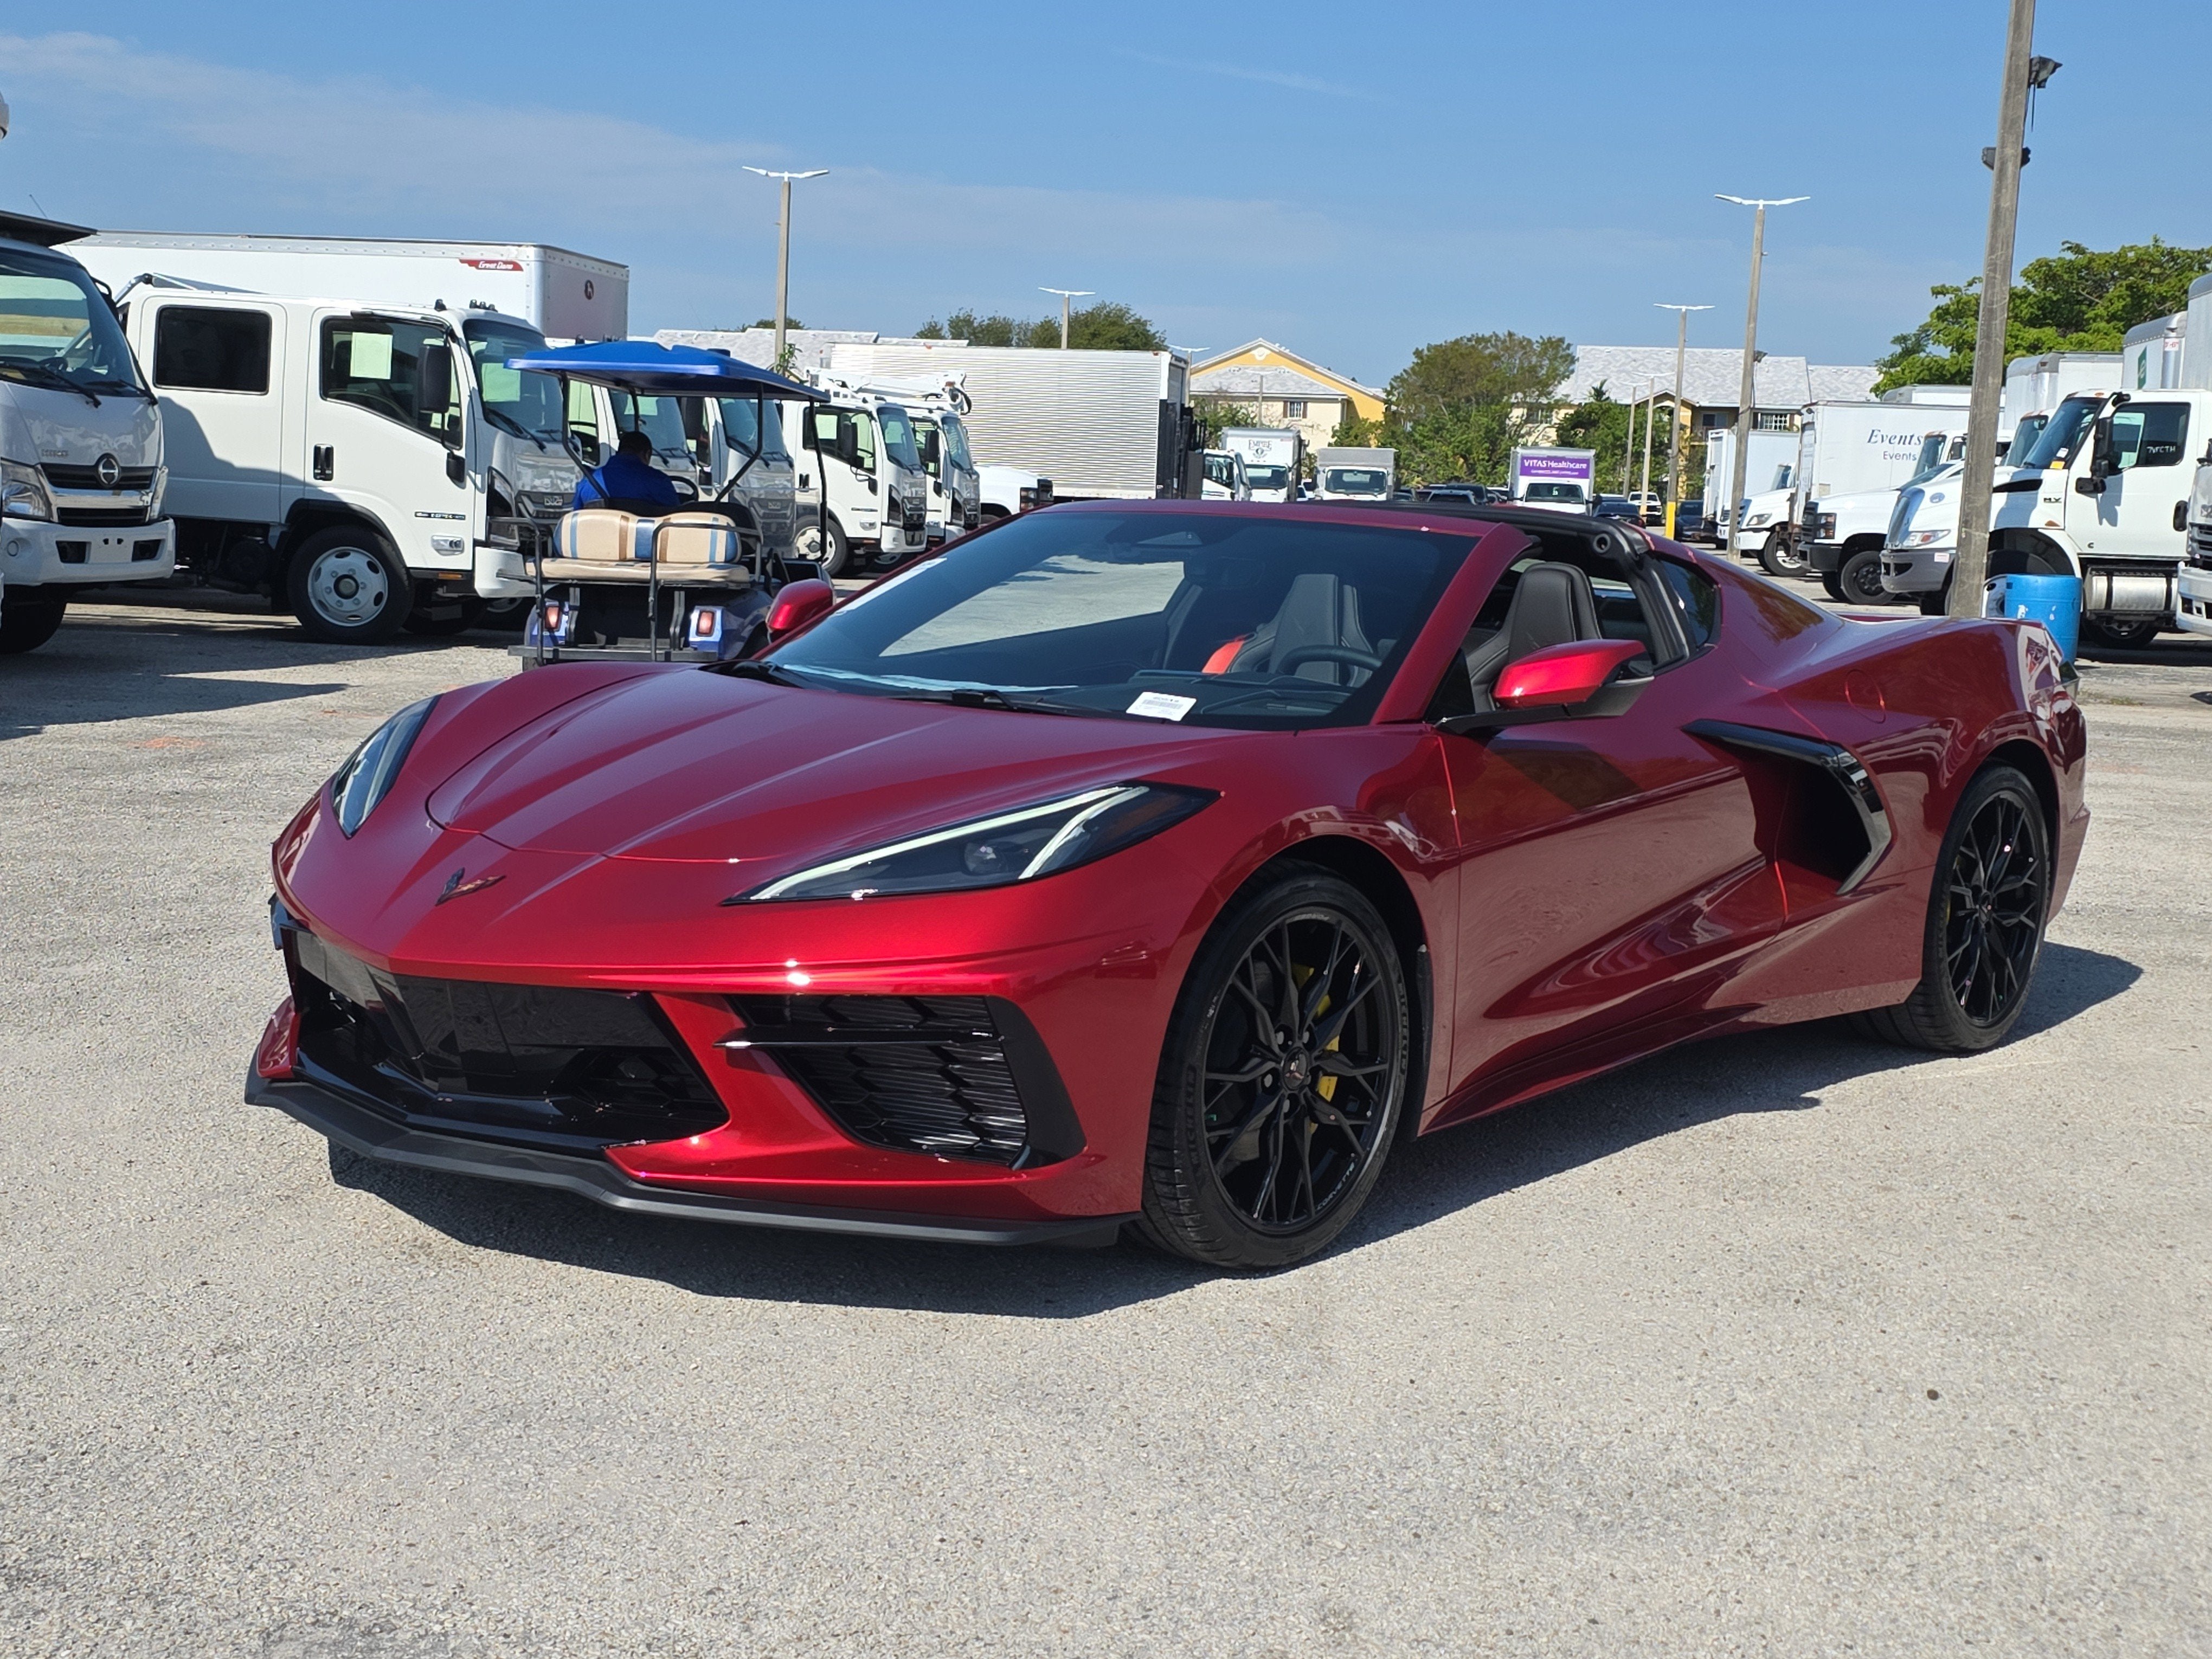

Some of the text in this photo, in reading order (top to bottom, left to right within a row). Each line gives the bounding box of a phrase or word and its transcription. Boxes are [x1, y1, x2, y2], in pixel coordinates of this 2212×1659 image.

[1867, 429, 1923, 445] Events
[1883, 451, 1917, 461] Events
[1523, 459, 1587, 469] VITAS Healthcare
